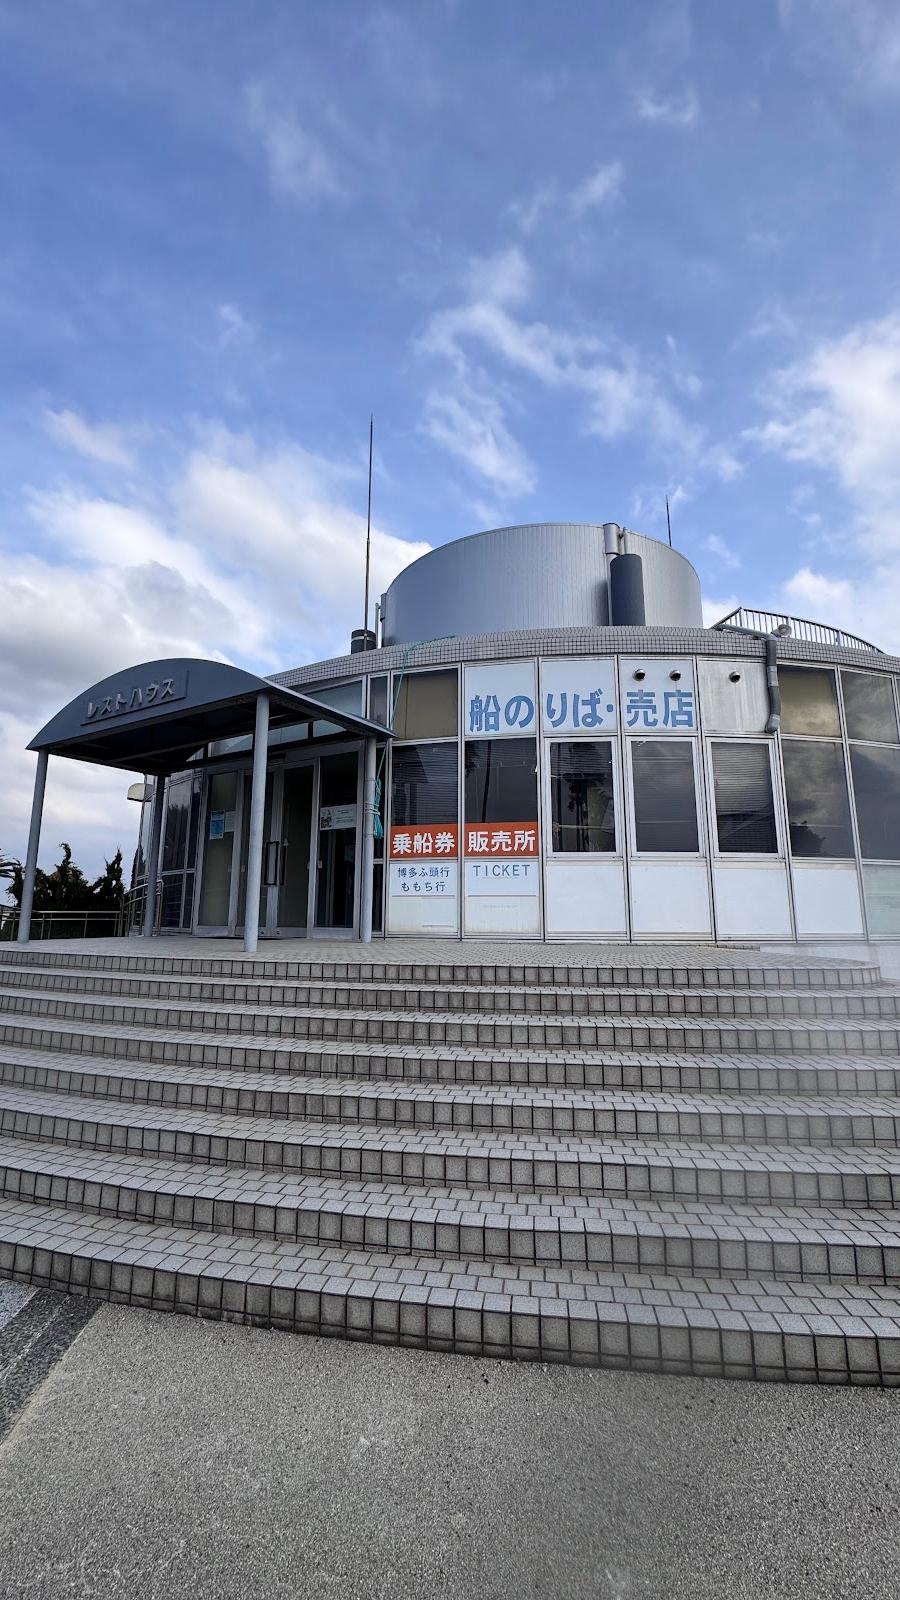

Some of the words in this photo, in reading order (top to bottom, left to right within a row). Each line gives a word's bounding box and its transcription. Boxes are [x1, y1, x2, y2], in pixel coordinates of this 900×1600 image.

[87, 679, 175, 719] レストハウス
[392, 832, 455, 854] 乗船券
[468, 830, 536, 853] 販売所
[397, 866, 450, 878] 博多ふ頭行
[473, 864, 530, 877] TICKET
[401, 881, 446, 892] ももち行
